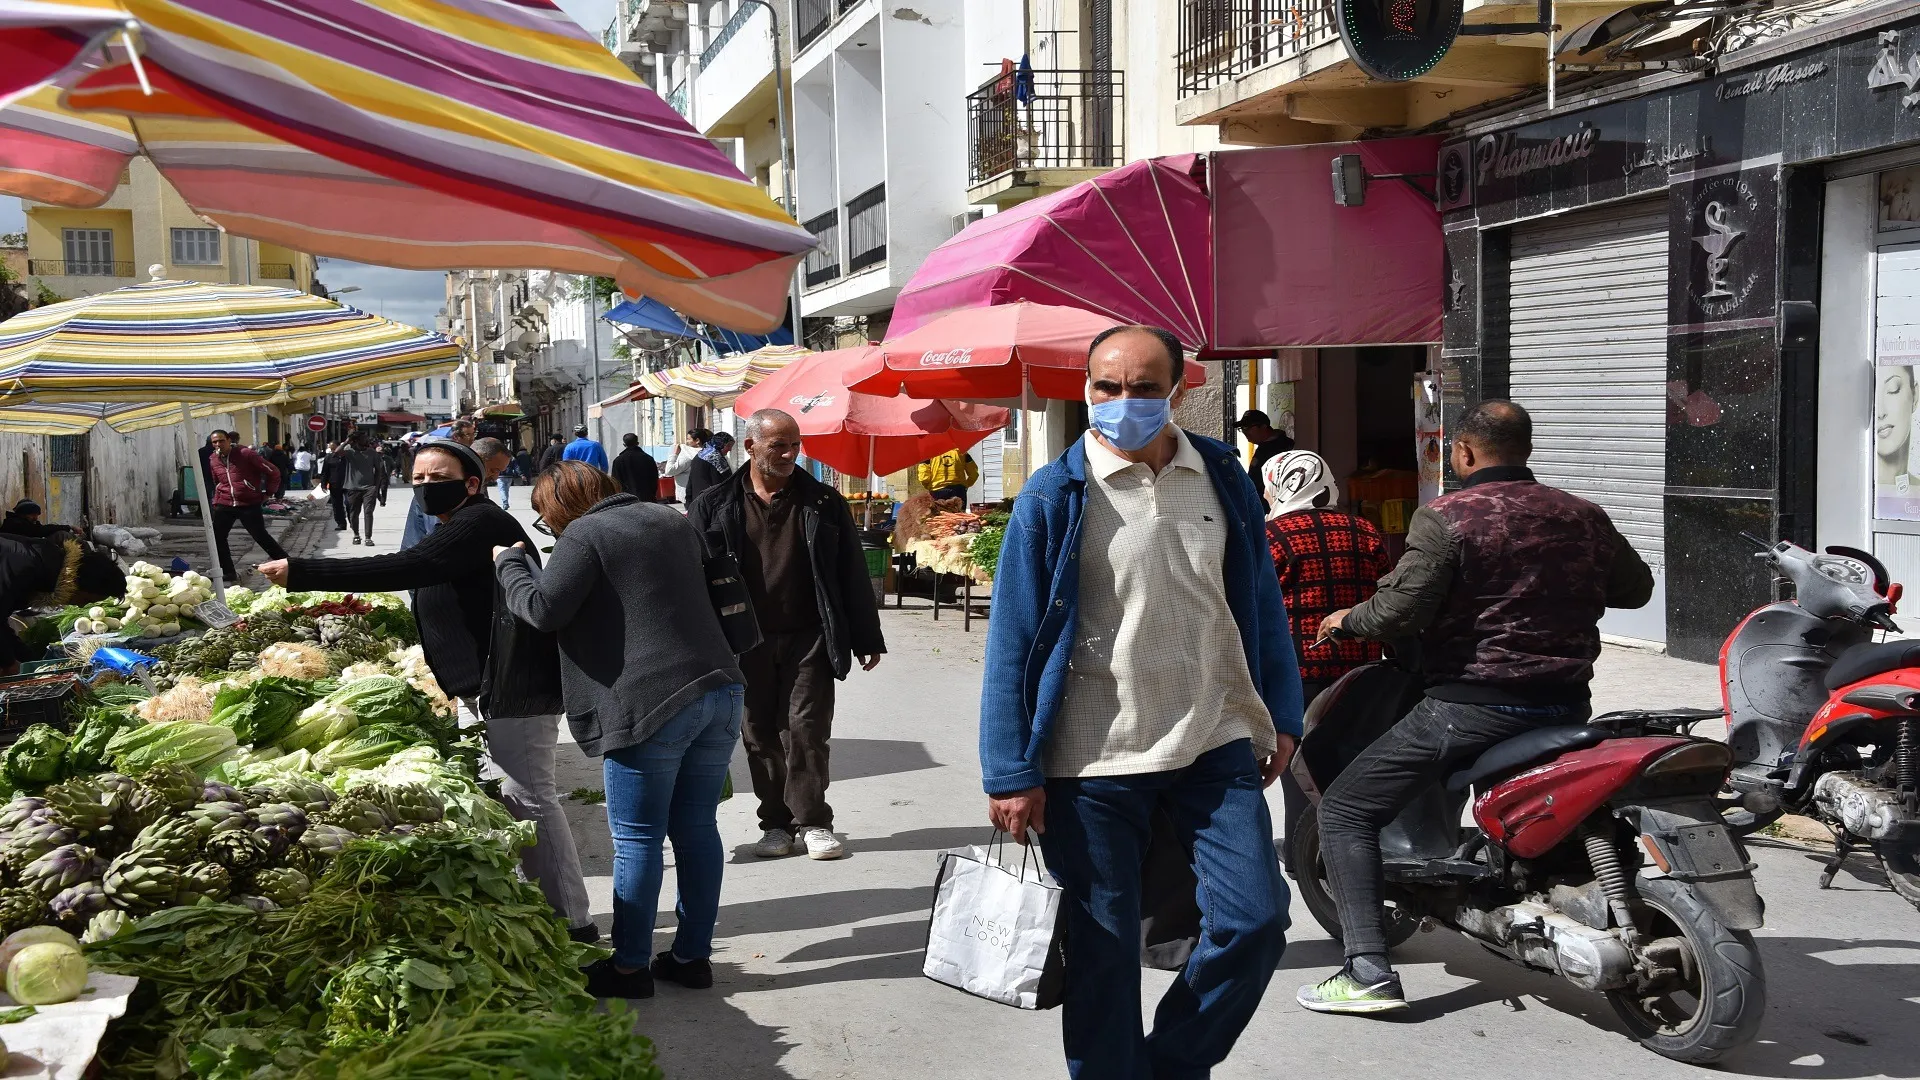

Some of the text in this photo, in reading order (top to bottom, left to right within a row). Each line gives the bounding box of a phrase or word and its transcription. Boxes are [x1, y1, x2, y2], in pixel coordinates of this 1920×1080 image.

[1476, 121, 1592, 186] Pharmacie
[1723, 177, 1734, 186] en
[1736, 181, 1758, 211] 1973
[919, 348, 973, 366] Coca-Cola
[1904, 501, 1920, 514] Gam
[972, 914, 1011, 938] NEW
[964, 926, 1011, 951] LOOK
